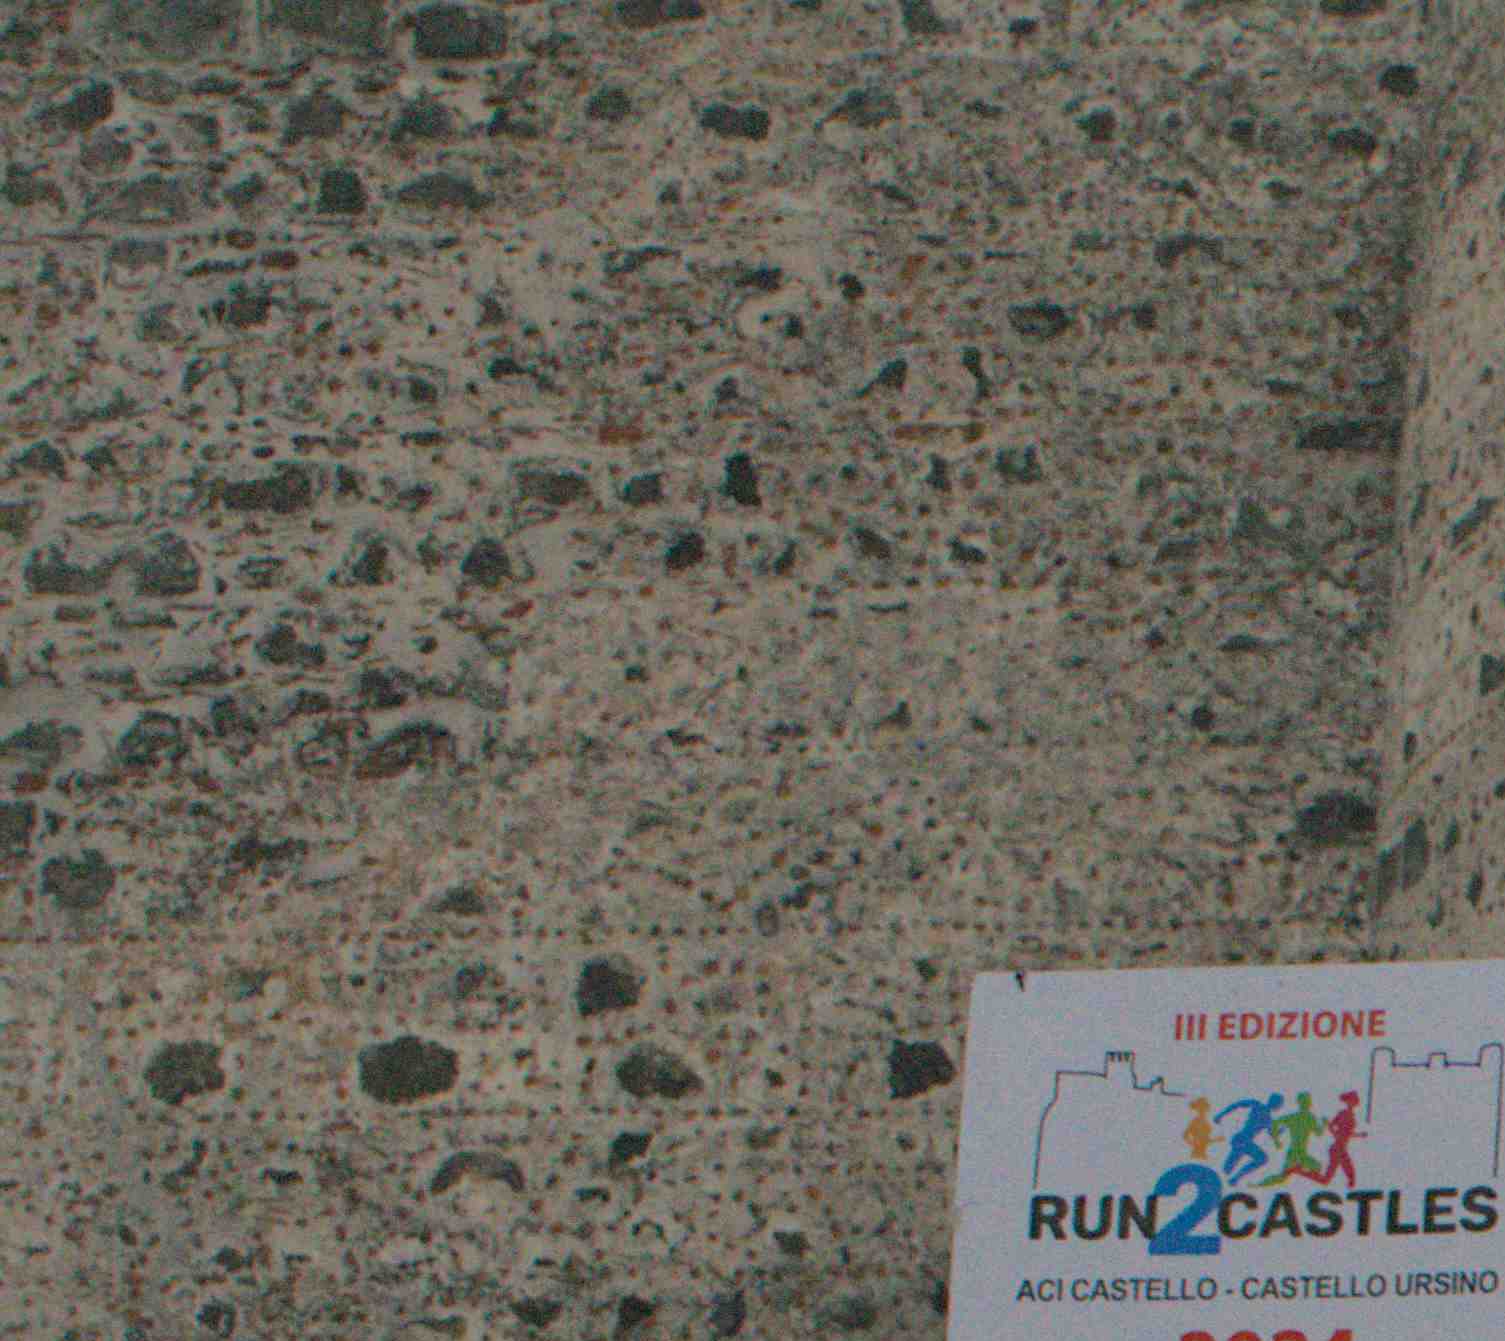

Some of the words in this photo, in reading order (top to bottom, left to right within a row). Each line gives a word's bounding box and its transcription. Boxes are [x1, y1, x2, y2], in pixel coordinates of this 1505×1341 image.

[1175, 1013, 1207, 1041] III
[1218, 1009, 1387, 1041] EDIZIONE
[1029, 1164, 1498, 1255] RUN2CASTLES
[1016, 1279, 1065, 1303] ACI
[1071, 1277, 1219, 1302] CASTELLO
[1241, 1274, 1387, 1300] CASTELLO
[1395, 1271, 1499, 1297] URSINO
